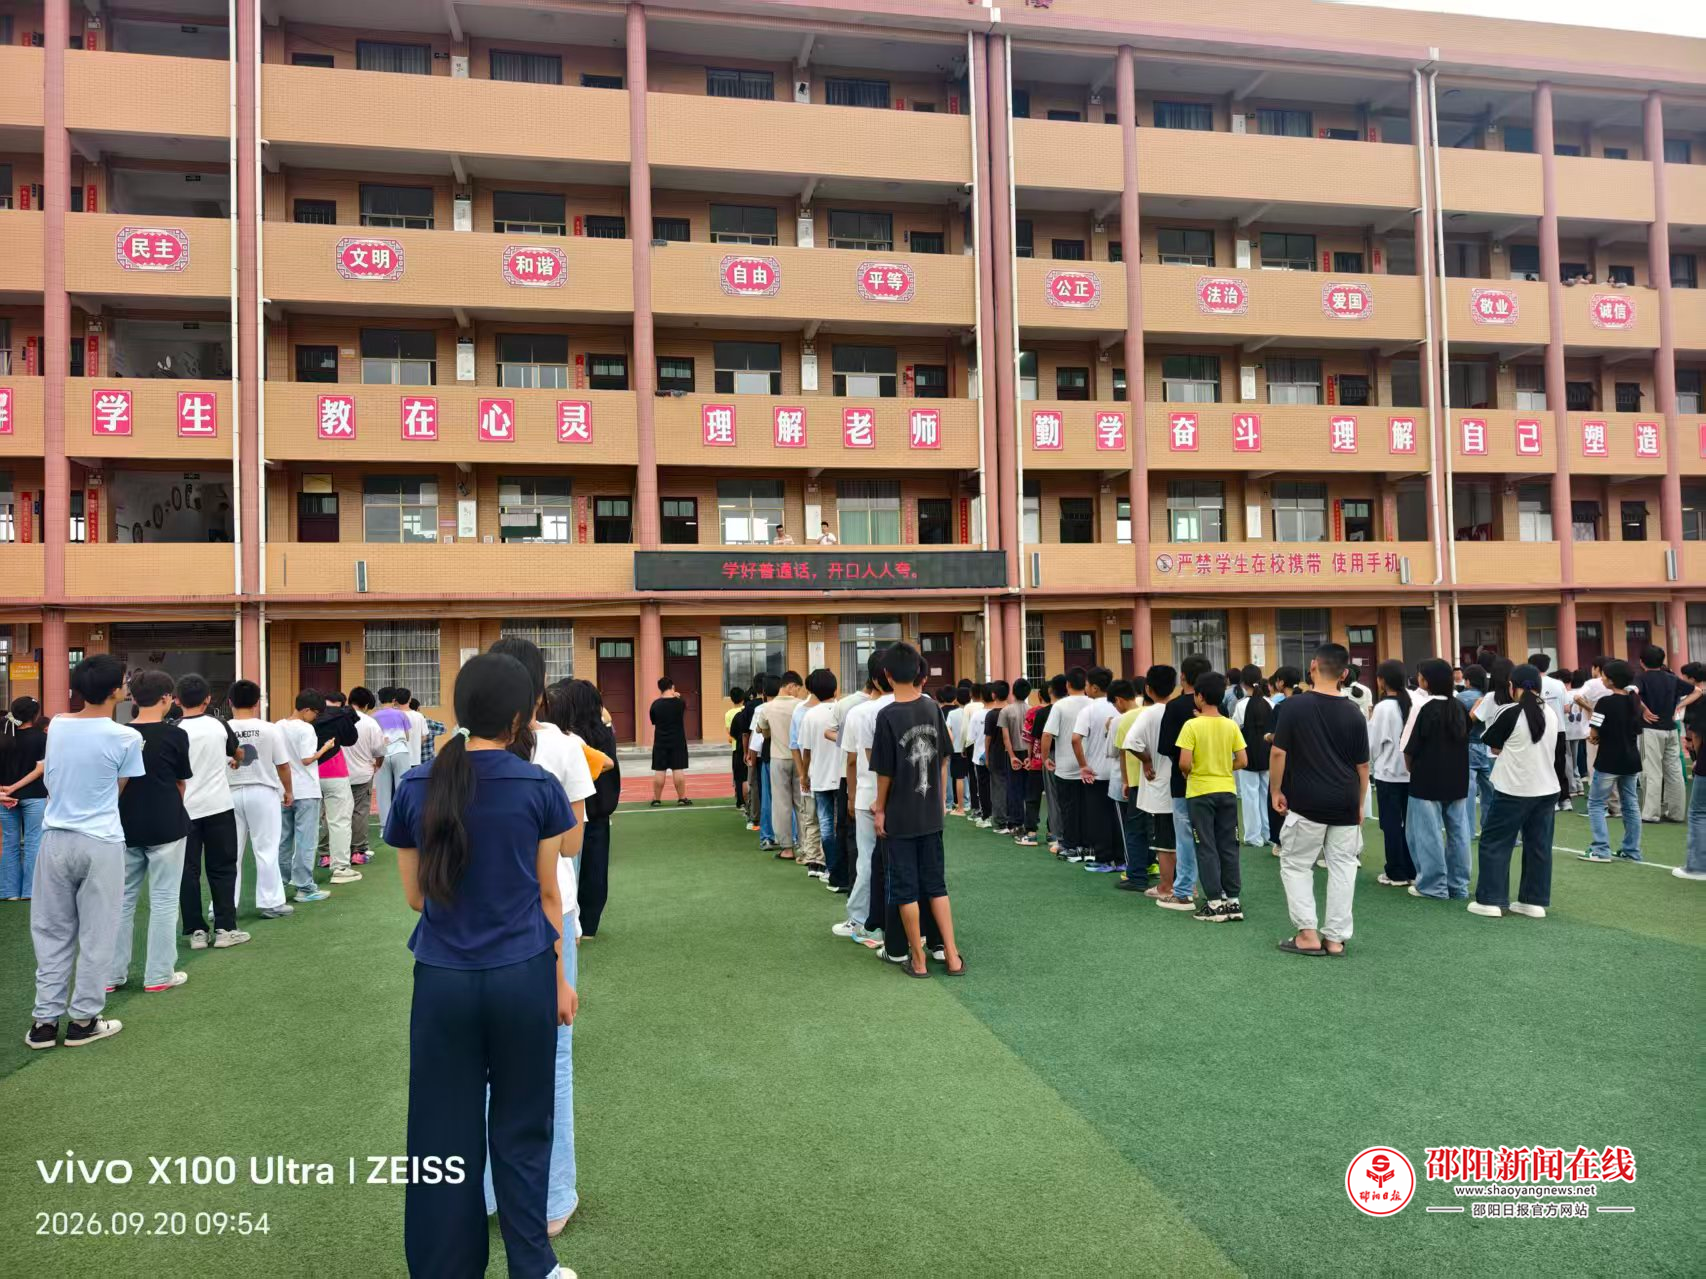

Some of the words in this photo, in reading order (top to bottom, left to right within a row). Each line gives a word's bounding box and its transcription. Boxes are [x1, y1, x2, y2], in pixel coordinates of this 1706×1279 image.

[130, 238, 174, 260] 民主
[349, 249, 391, 271] 文明
[515, 256, 555, 277] 和谐
[732, 265, 768, 285] 自由
[868, 272, 903, 291] 平等
[1056, 280, 1090, 297] 公正
[1207, 286, 1239, 304] 法治
[1332, 292, 1363, 310] 爱国
[1479, 297, 1510, 315] 敬业
[1599, 303, 1627, 321] 诚信
[235, 730, 260, 738] OJECTS
